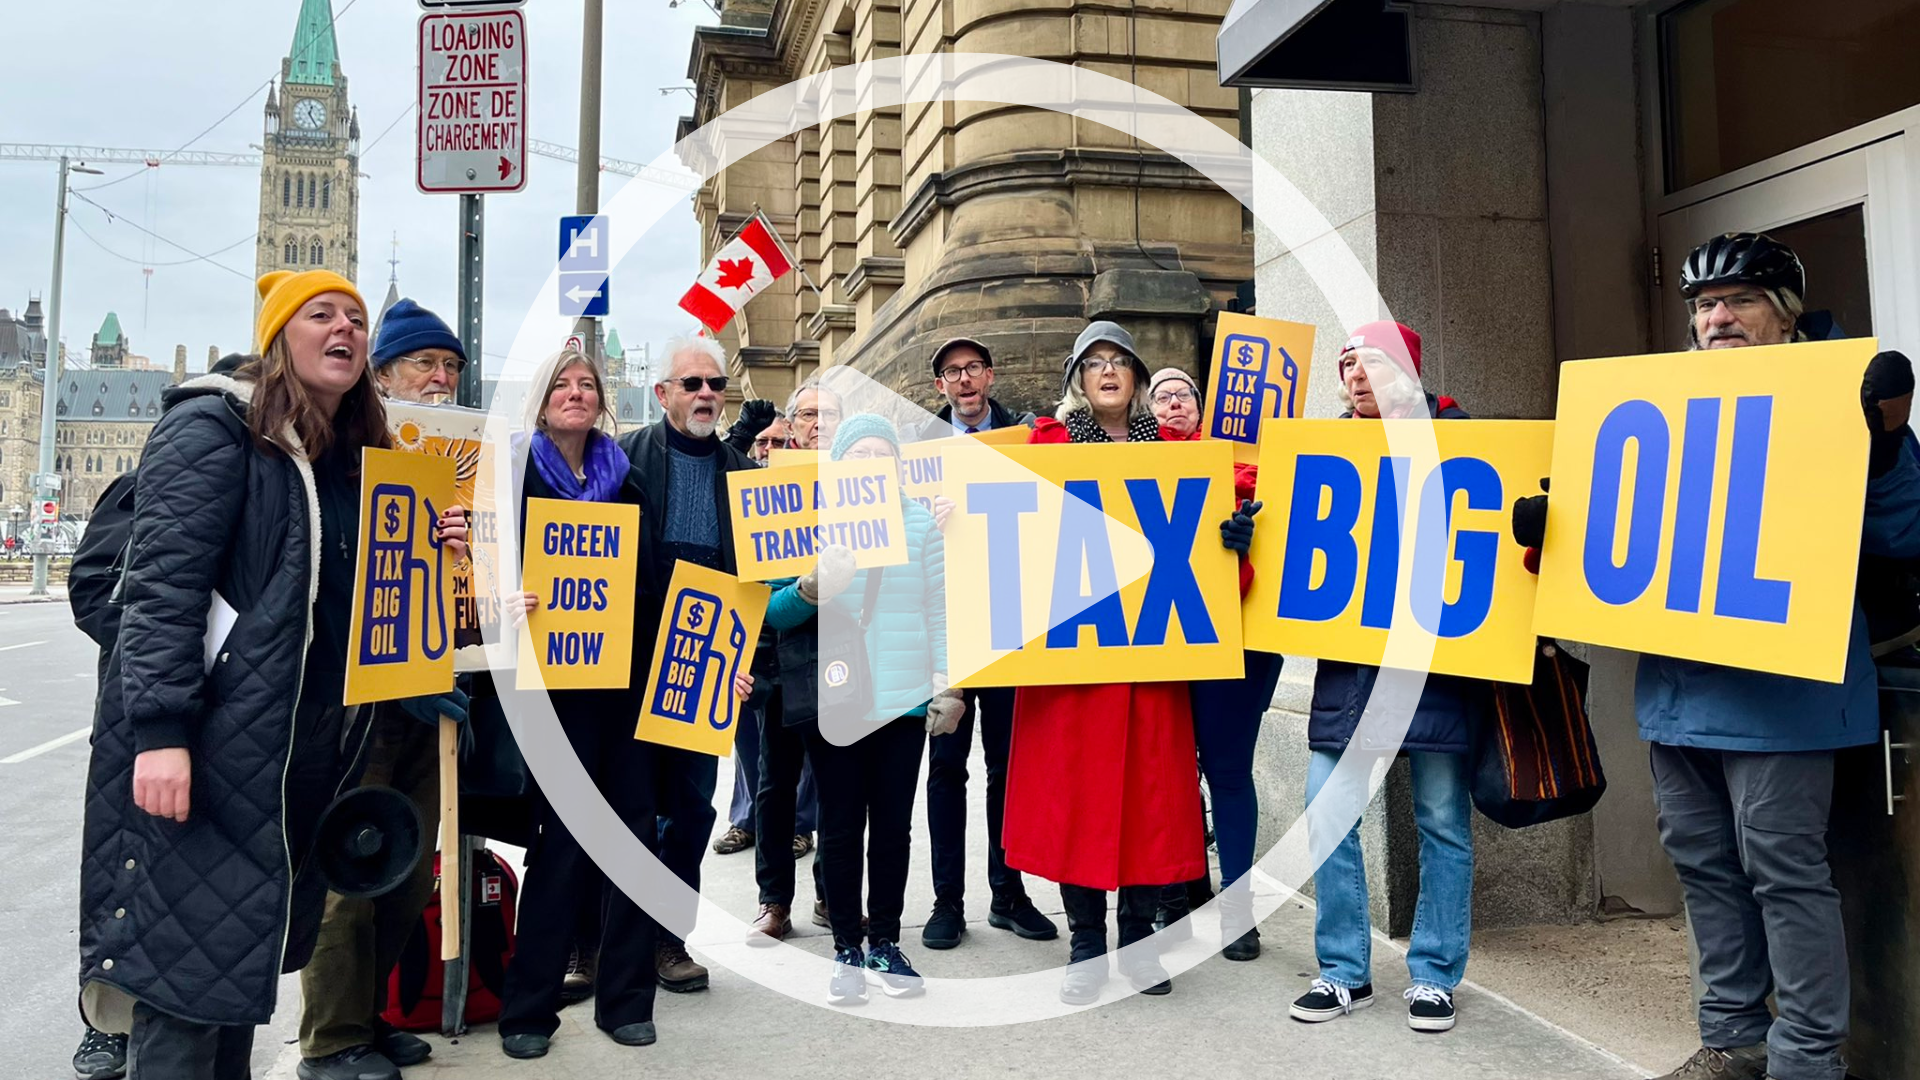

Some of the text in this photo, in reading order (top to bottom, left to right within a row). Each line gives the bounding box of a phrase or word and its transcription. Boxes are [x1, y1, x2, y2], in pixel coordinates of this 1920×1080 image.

[431, 20, 514, 51] LOADING
[446, 53, 499, 82] ZONE
[428, 90, 517, 120] ZONE DE
[426, 122, 518, 151] CHARGEMENT
[570, 227, 598, 258] H
[1227, 372, 1257, 394] TAX
[1223, 394, 1252, 416] BIG
[1221, 416, 1247, 437] OIL
[740, 483, 803, 518] FUND
[813, 480, 827, 510] A
[836, 474, 886, 508] JUST
[1583, 395, 1791, 624] OIL
[463, 510, 497, 543] FREE
[543, 522, 620, 558] GREEN
[750, 518, 890, 562] TRANSITION
[1276, 453, 1503, 638] BIG
[374, 549, 405, 580] TAX
[966, 477, 1219, 650] TAX
[371, 586, 400, 618] BIG
[547, 577, 608, 611] JOBS
[455, 597, 501, 629] FUELS
[370, 623, 397, 656] OIL
[547, 632, 604, 665] NOW
[673, 634, 704, 662] TAX
[667, 661, 696, 688] BIG
[662, 688, 687, 715] OIL
